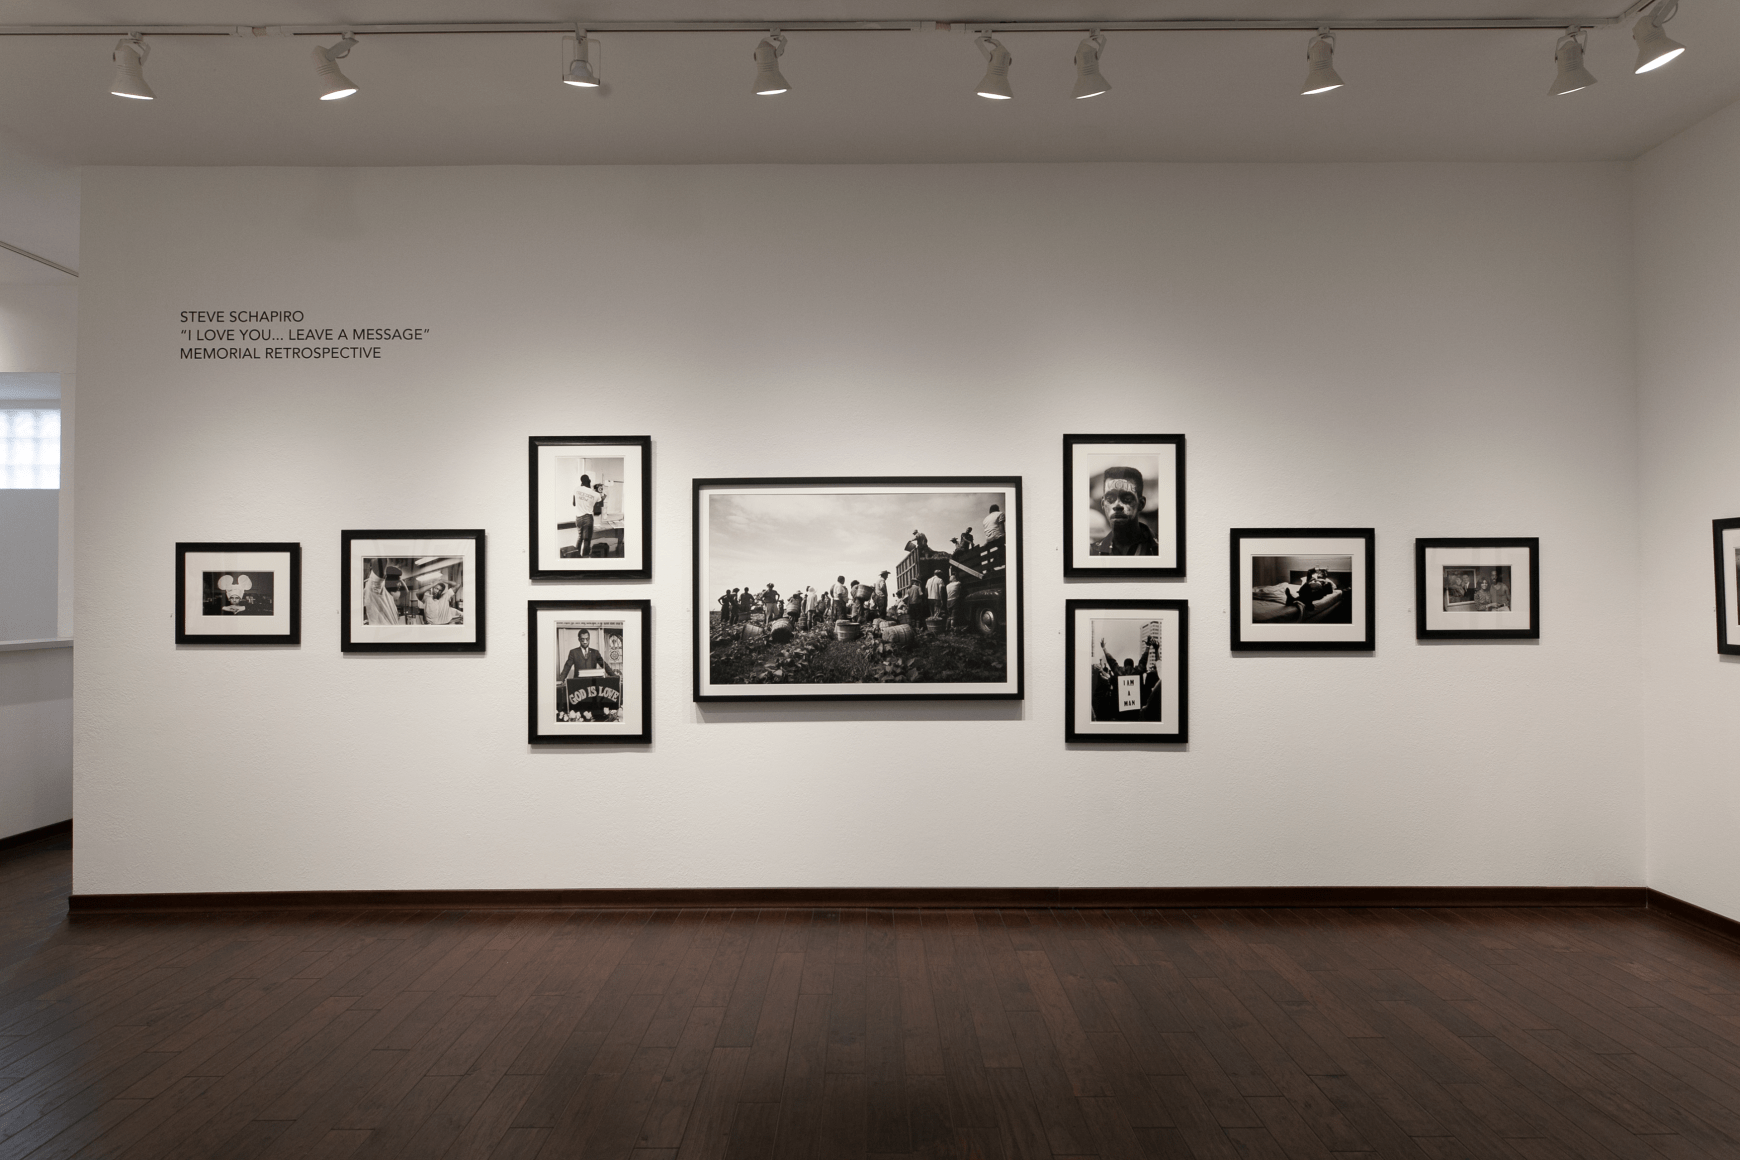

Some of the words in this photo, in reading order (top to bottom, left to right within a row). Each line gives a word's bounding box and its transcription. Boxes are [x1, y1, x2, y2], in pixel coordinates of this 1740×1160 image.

[180, 310, 225, 323] STEVE
[229, 310, 305, 323] SCHAPIRO
[196, 329, 236, 341] LOVE
[239, 328, 284, 341] YOU...
[288, 328, 334, 341] LEAVE
[337, 328, 349, 341] A
[180, 347, 261, 360] MEMORIAL
[265, 346, 382, 359] RETROSPECTIVE
[569, 688, 587, 705] GOD
[587, 685, 597, 697] IS
[598, 685, 620, 702] LOVE
